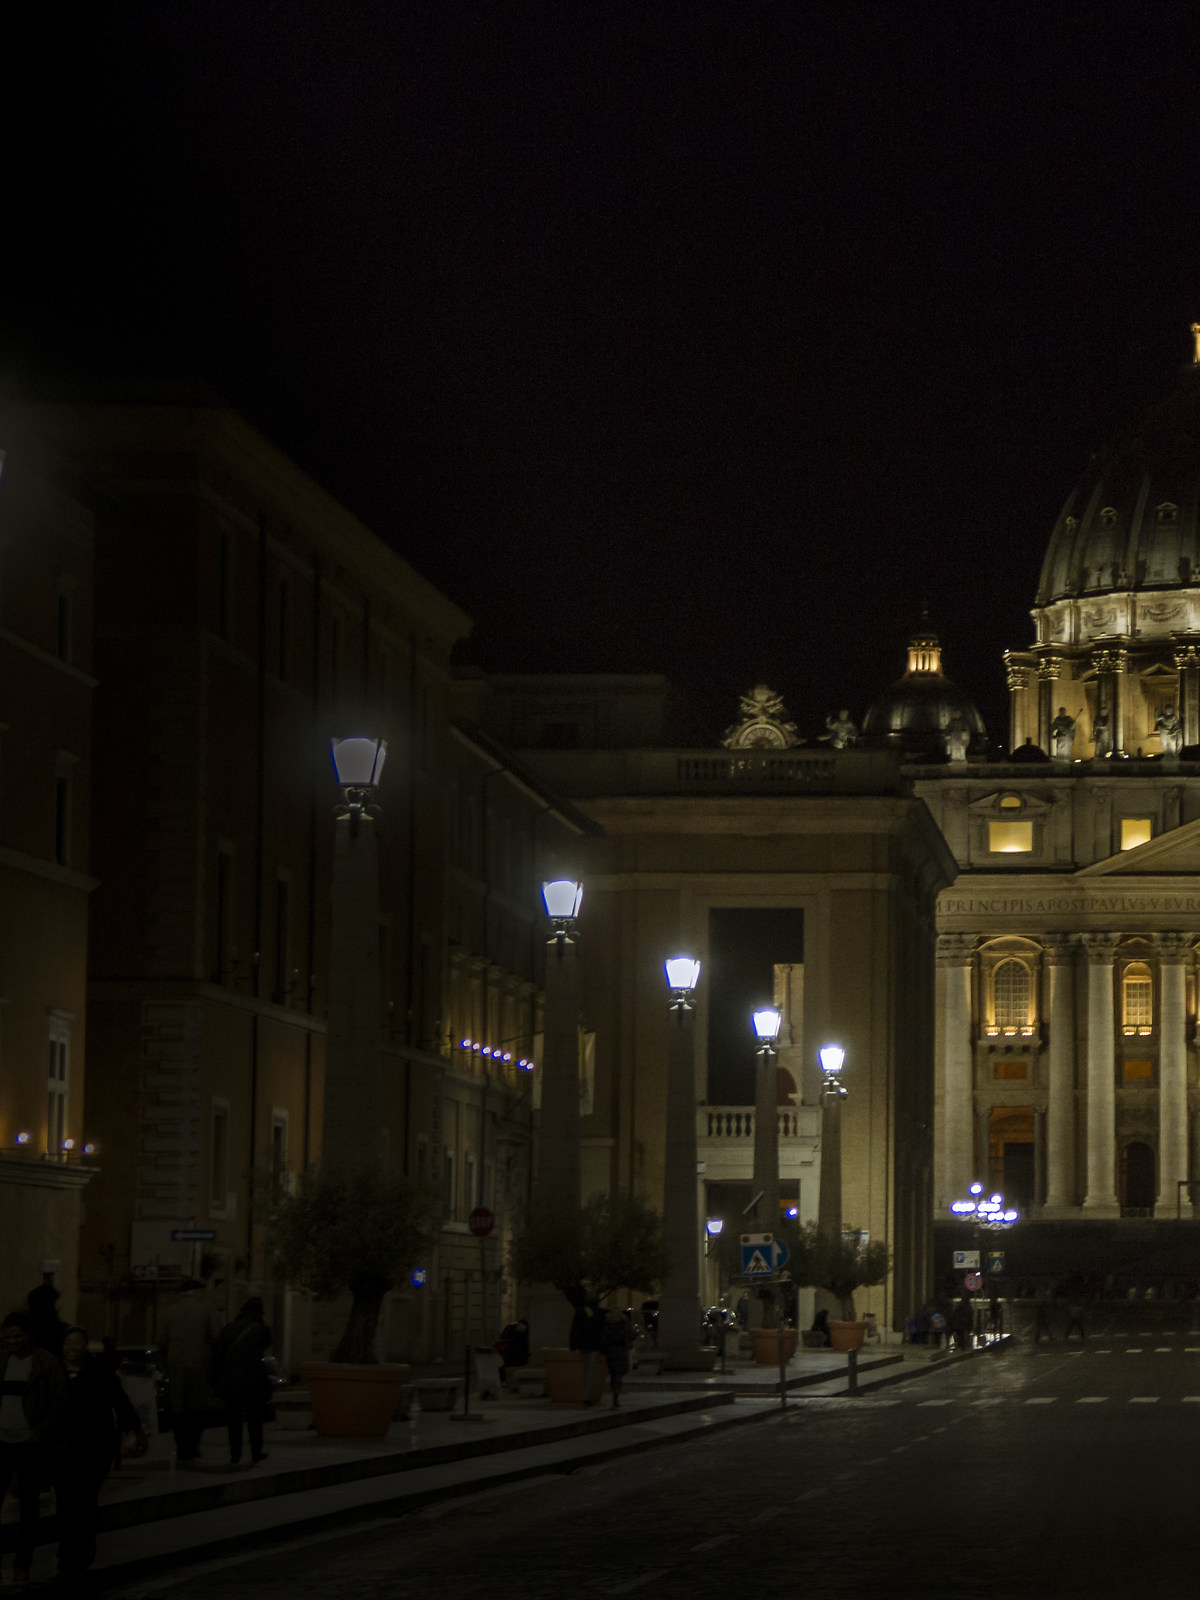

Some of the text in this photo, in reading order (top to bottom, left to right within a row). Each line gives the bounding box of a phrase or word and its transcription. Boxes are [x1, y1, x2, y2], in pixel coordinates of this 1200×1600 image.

[947, 899, 1033, 912] PRINCIPIS
[1036, 898, 1088, 912] APOST
[1090, 898, 1146, 911] PAVLVS
